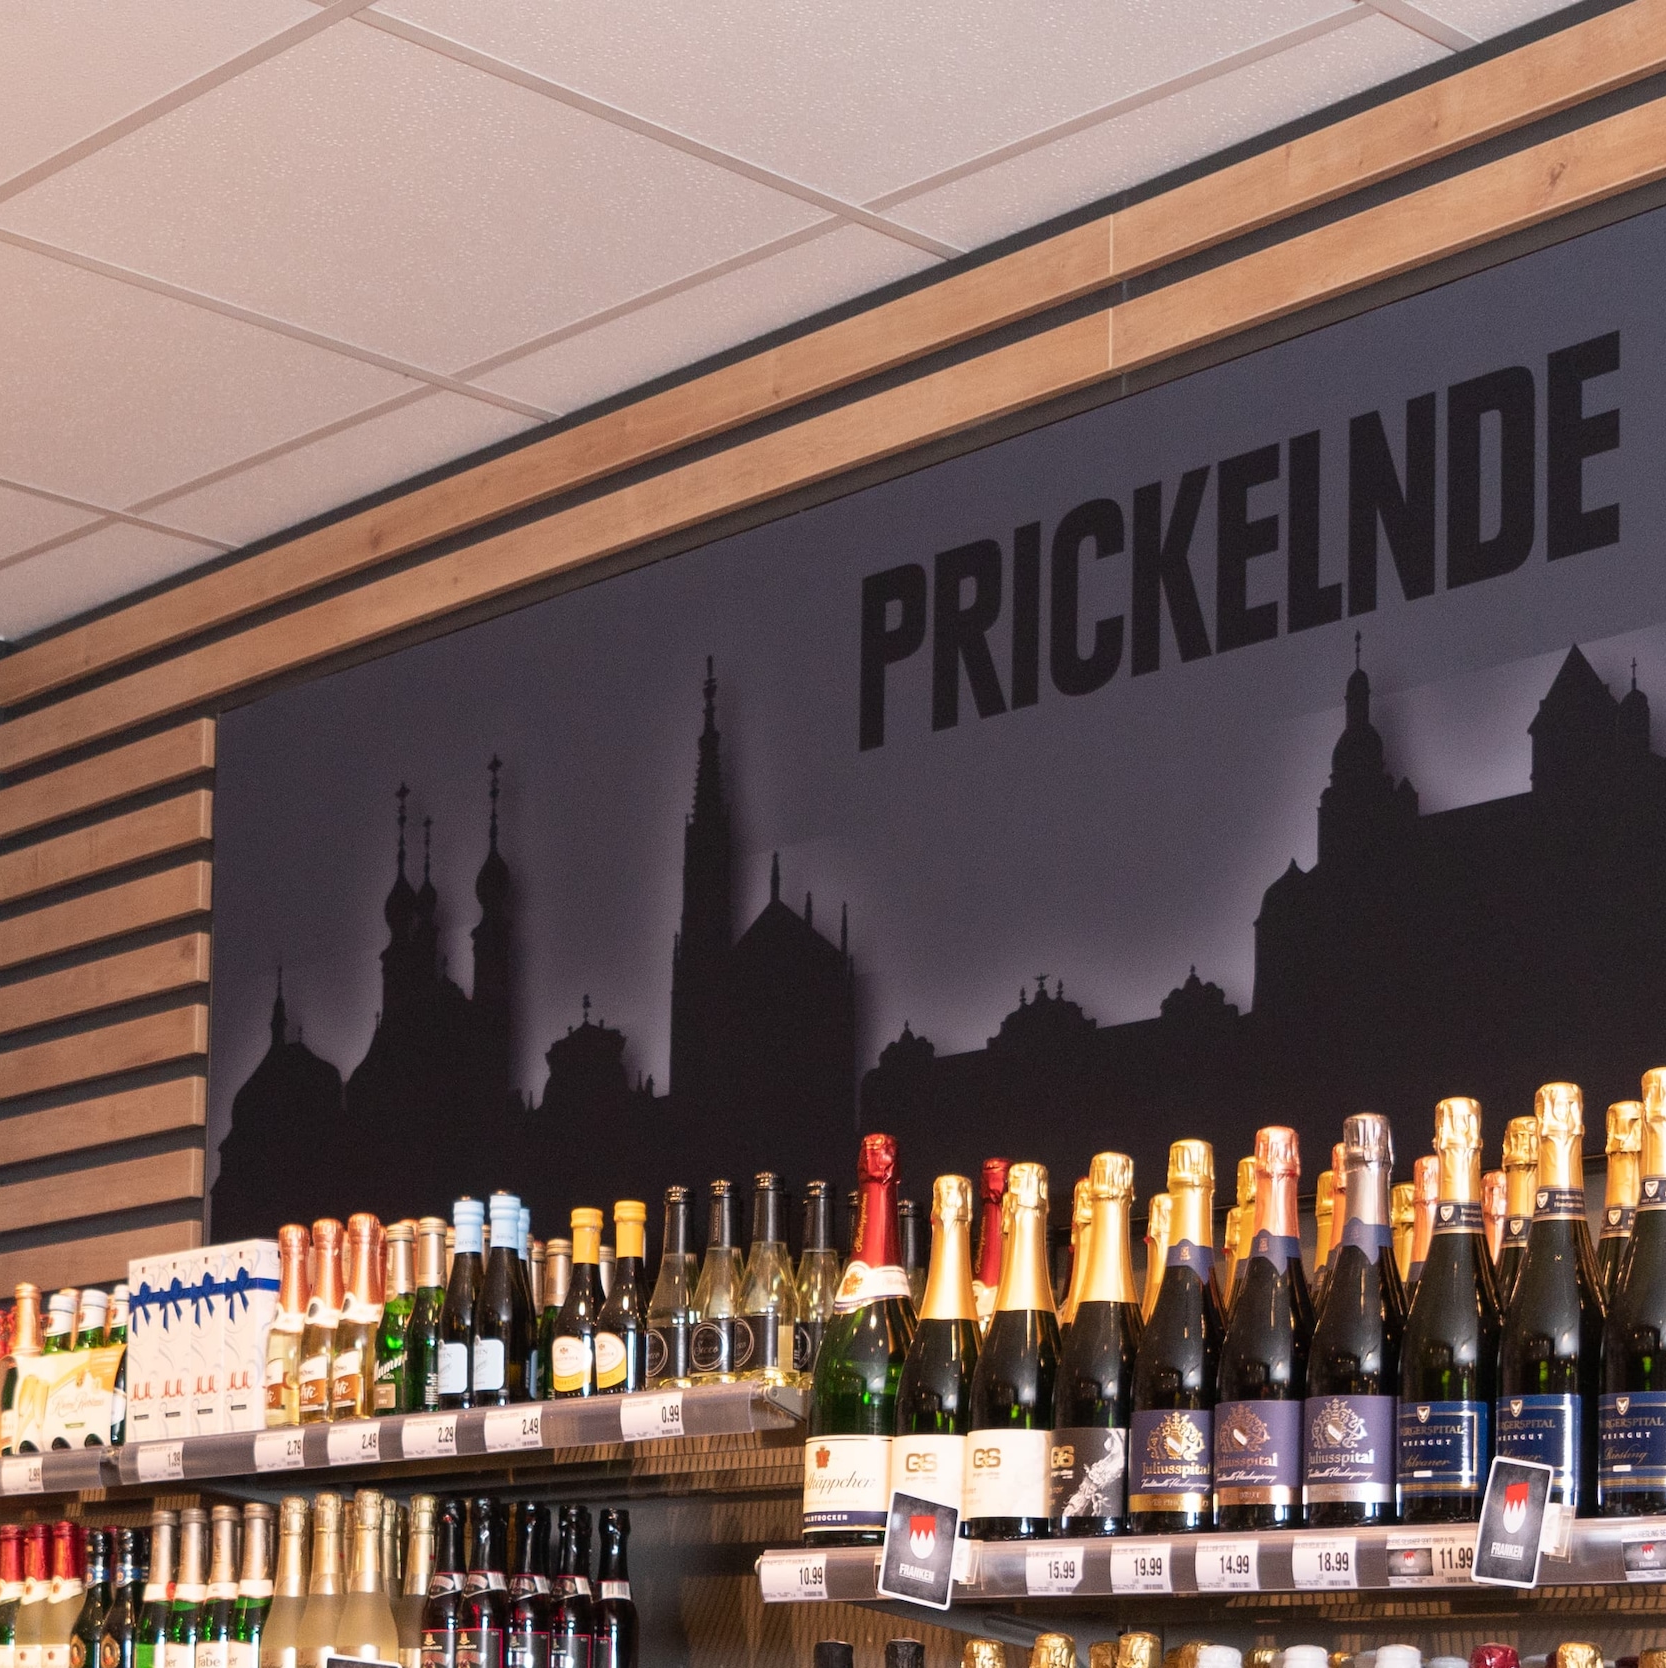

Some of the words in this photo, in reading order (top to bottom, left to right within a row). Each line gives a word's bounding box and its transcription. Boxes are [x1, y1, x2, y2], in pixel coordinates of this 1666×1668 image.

[857, 329, 1620, 752] PRICKELNDE
[661, 1405, 680, 1424] 0.99
[1308, 1449, 1374, 1466] Juliusspital
[1142, 1461, 1210, 1478] Juliusspital
[1440, 1547, 1473, 1569] 11.99
[1491, 1542, 1524, 1557] FRANKEN
[1048, 1561, 1075, 1579] 15.99
[1134, 1558, 1162, 1576] 19.99
[1220, 1555, 1249, 1574] 14.99
[1318, 1552, 1349, 1571] 18.99
[799, 1567, 823, 1585] 10.99
[899, 1563, 935, 1580] FRANKEN
